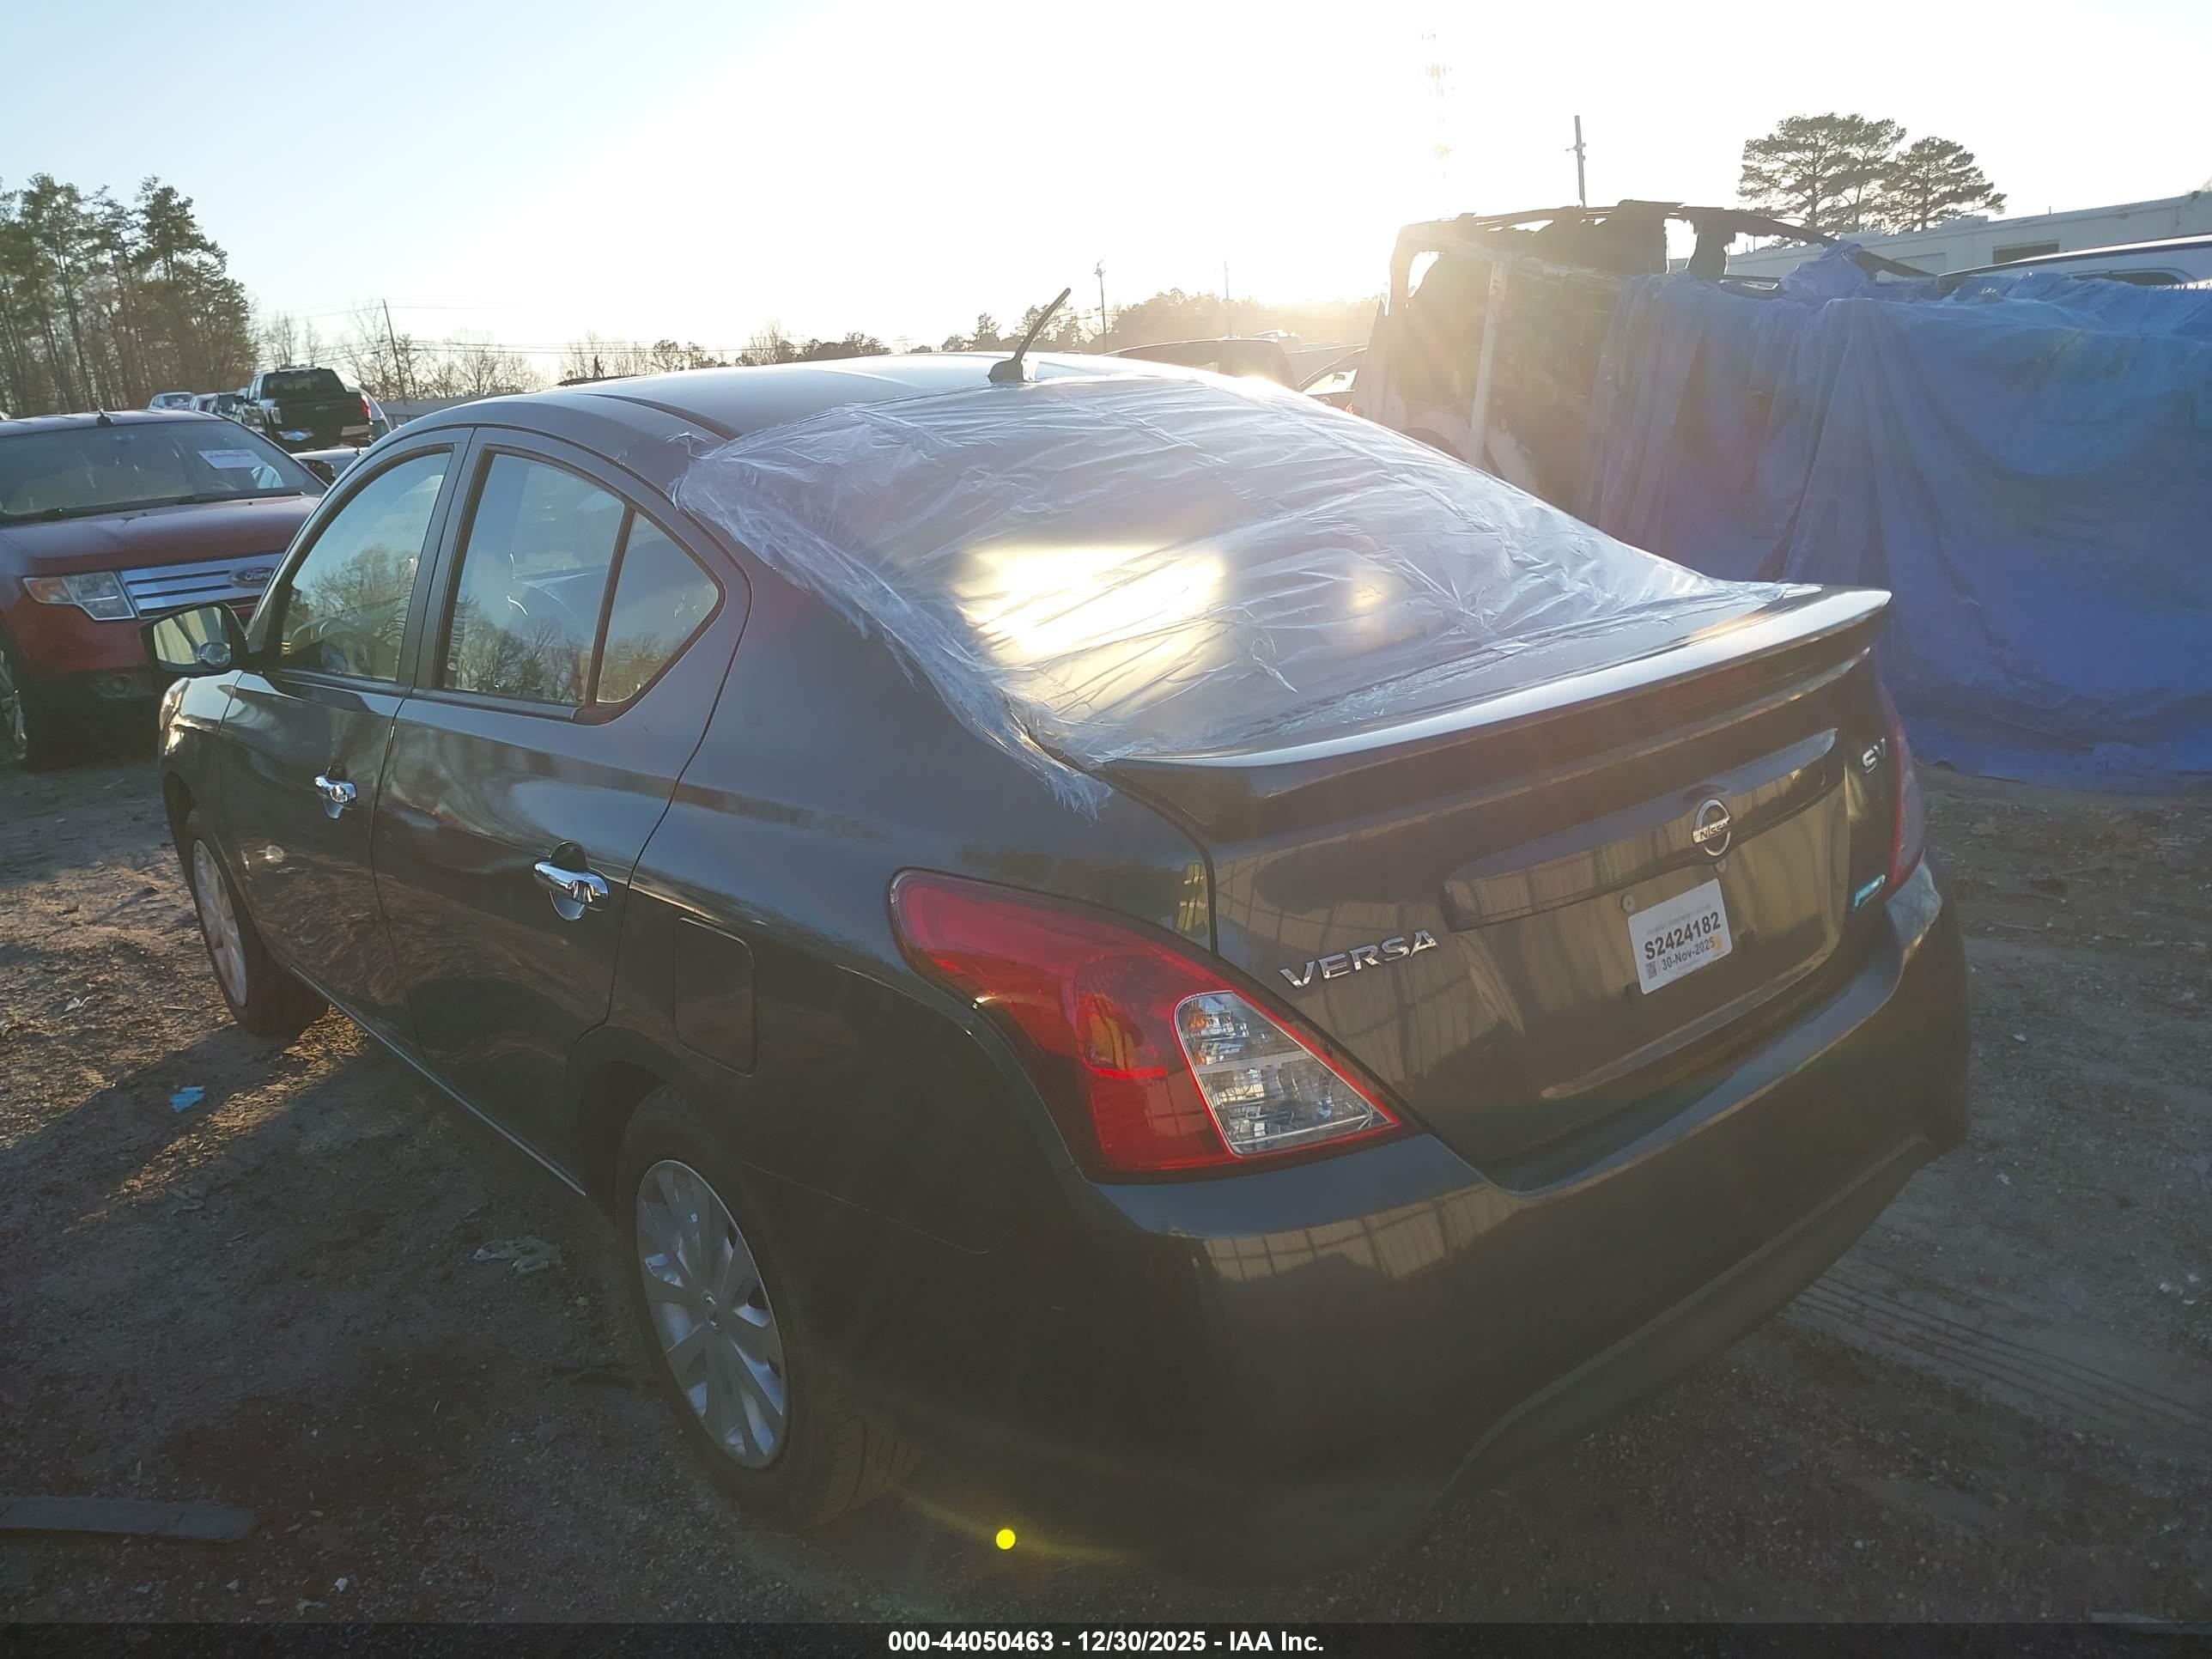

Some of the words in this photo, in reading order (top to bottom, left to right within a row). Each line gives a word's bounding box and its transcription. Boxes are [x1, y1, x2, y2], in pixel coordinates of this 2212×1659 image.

[1279, 929, 1438, 988] VERSA
[1644, 911, 1721, 961] S2424182
[1661, 936, 1715, 971] 30-Nov-2025
